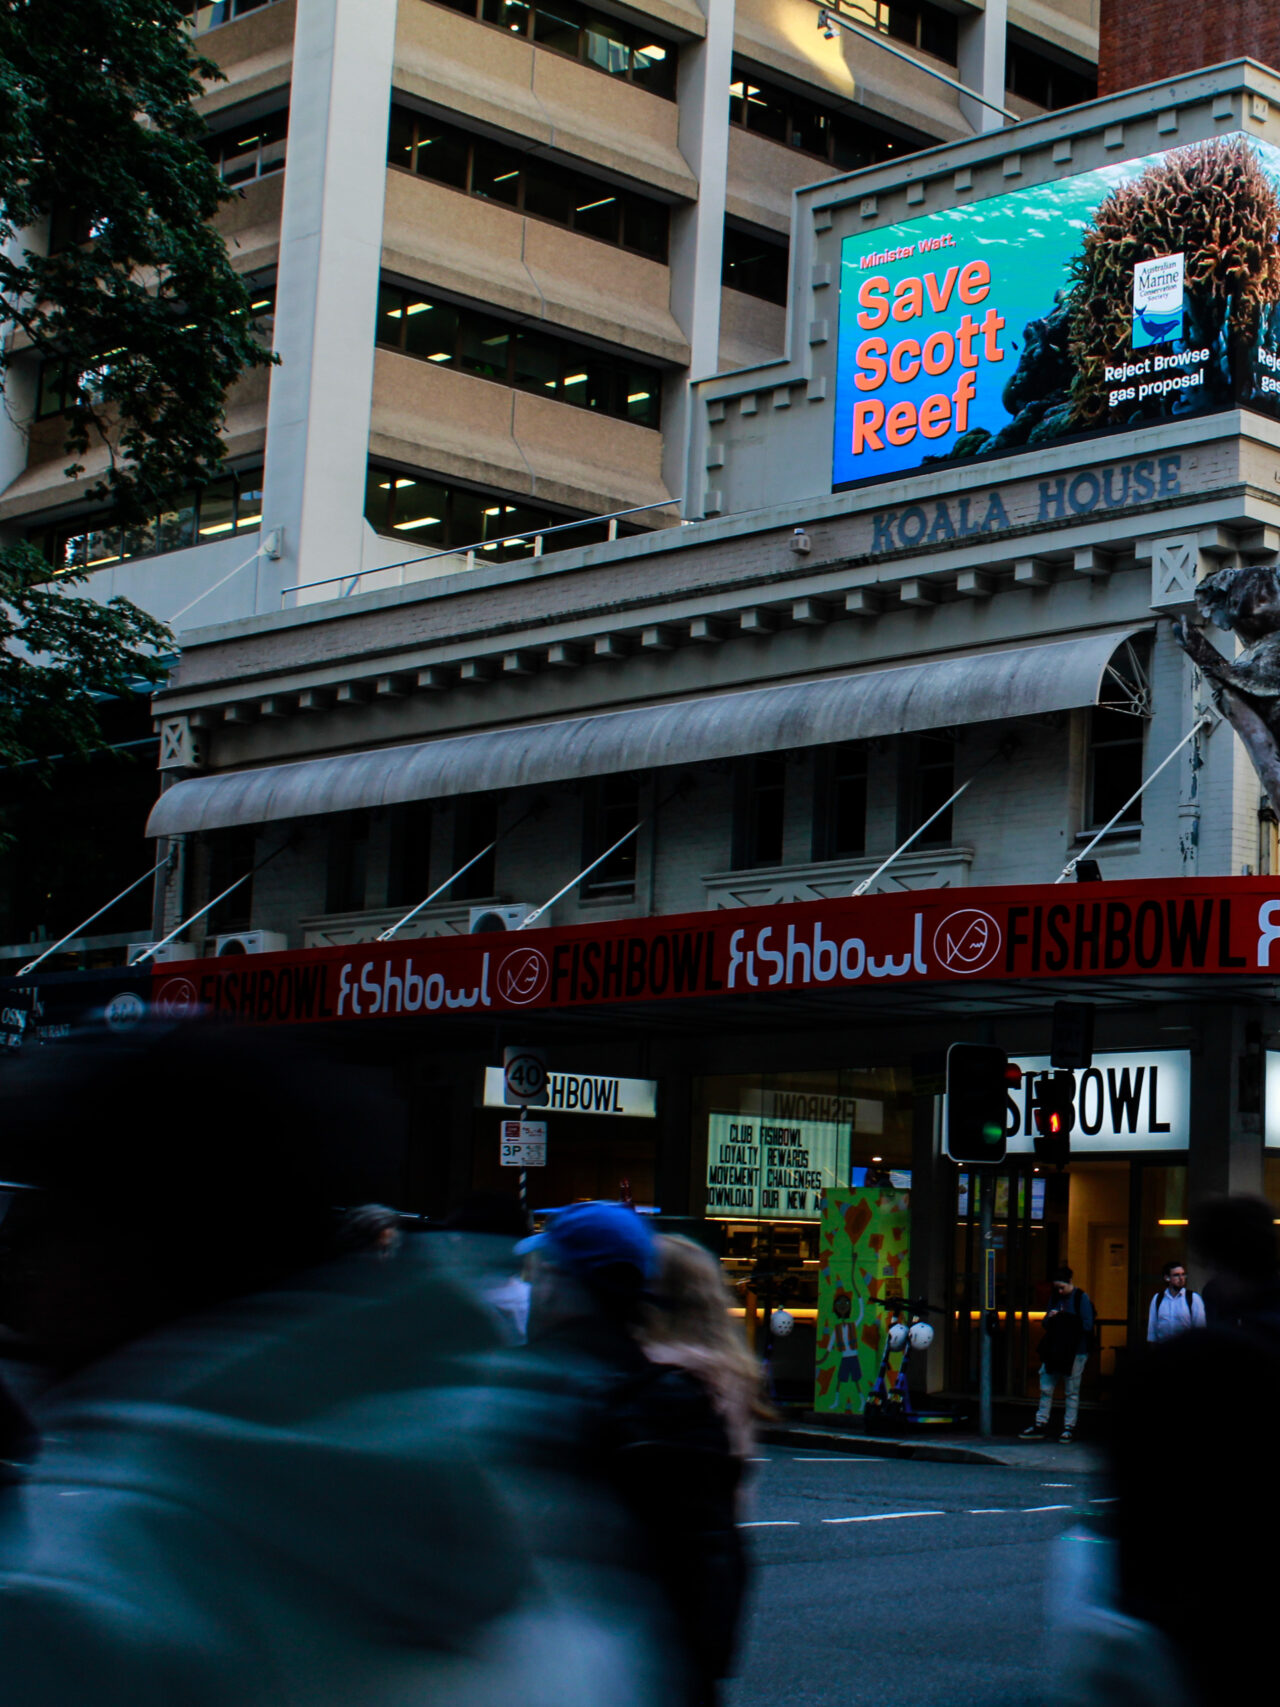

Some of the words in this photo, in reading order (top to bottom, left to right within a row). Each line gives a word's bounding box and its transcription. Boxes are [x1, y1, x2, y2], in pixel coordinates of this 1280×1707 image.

[860, 244, 915, 270] Minister
[918, 233, 956, 253] Watt,
[1138, 269, 1180, 291] Marine
[1141, 261, 1177, 275] Australian
[857, 260, 991, 331] Save
[1139, 283, 1178, 298] Conservation
[854, 308, 1005, 391] Scott
[1104, 357, 1151, 383] Reject
[1154, 347, 1210, 372] Browse
[1108, 385, 1136, 407] gas
[1138, 368, 1204, 401] proposal
[851, 371, 977, 455] Reef
[871, 491, 1011, 552] KOALA
[1038, 455, 1182, 521] HOUSE
[551, 931, 724, 1002] FISHBOWL
[1005, 899, 1247, 972] FISHBOWL
[510, 1065, 540, 1086] 40
[545, 1074, 623, 1112] HBOWL
[503, 1145, 521, 1156] 3P
[730, 1124, 753, 1144] CLUB
[760, 1126, 802, 1147] FISHBOWL
[720, 1144, 758, 1165] LOYALTY
[767, 1148, 809, 1168] REWARDS
[709, 1166, 760, 1186] MOVEMENT
[767, 1168, 822, 1190] CHALLENGES
[762, 1190, 780, 1209] OUR
[786, 1190, 806, 1210] NEW
